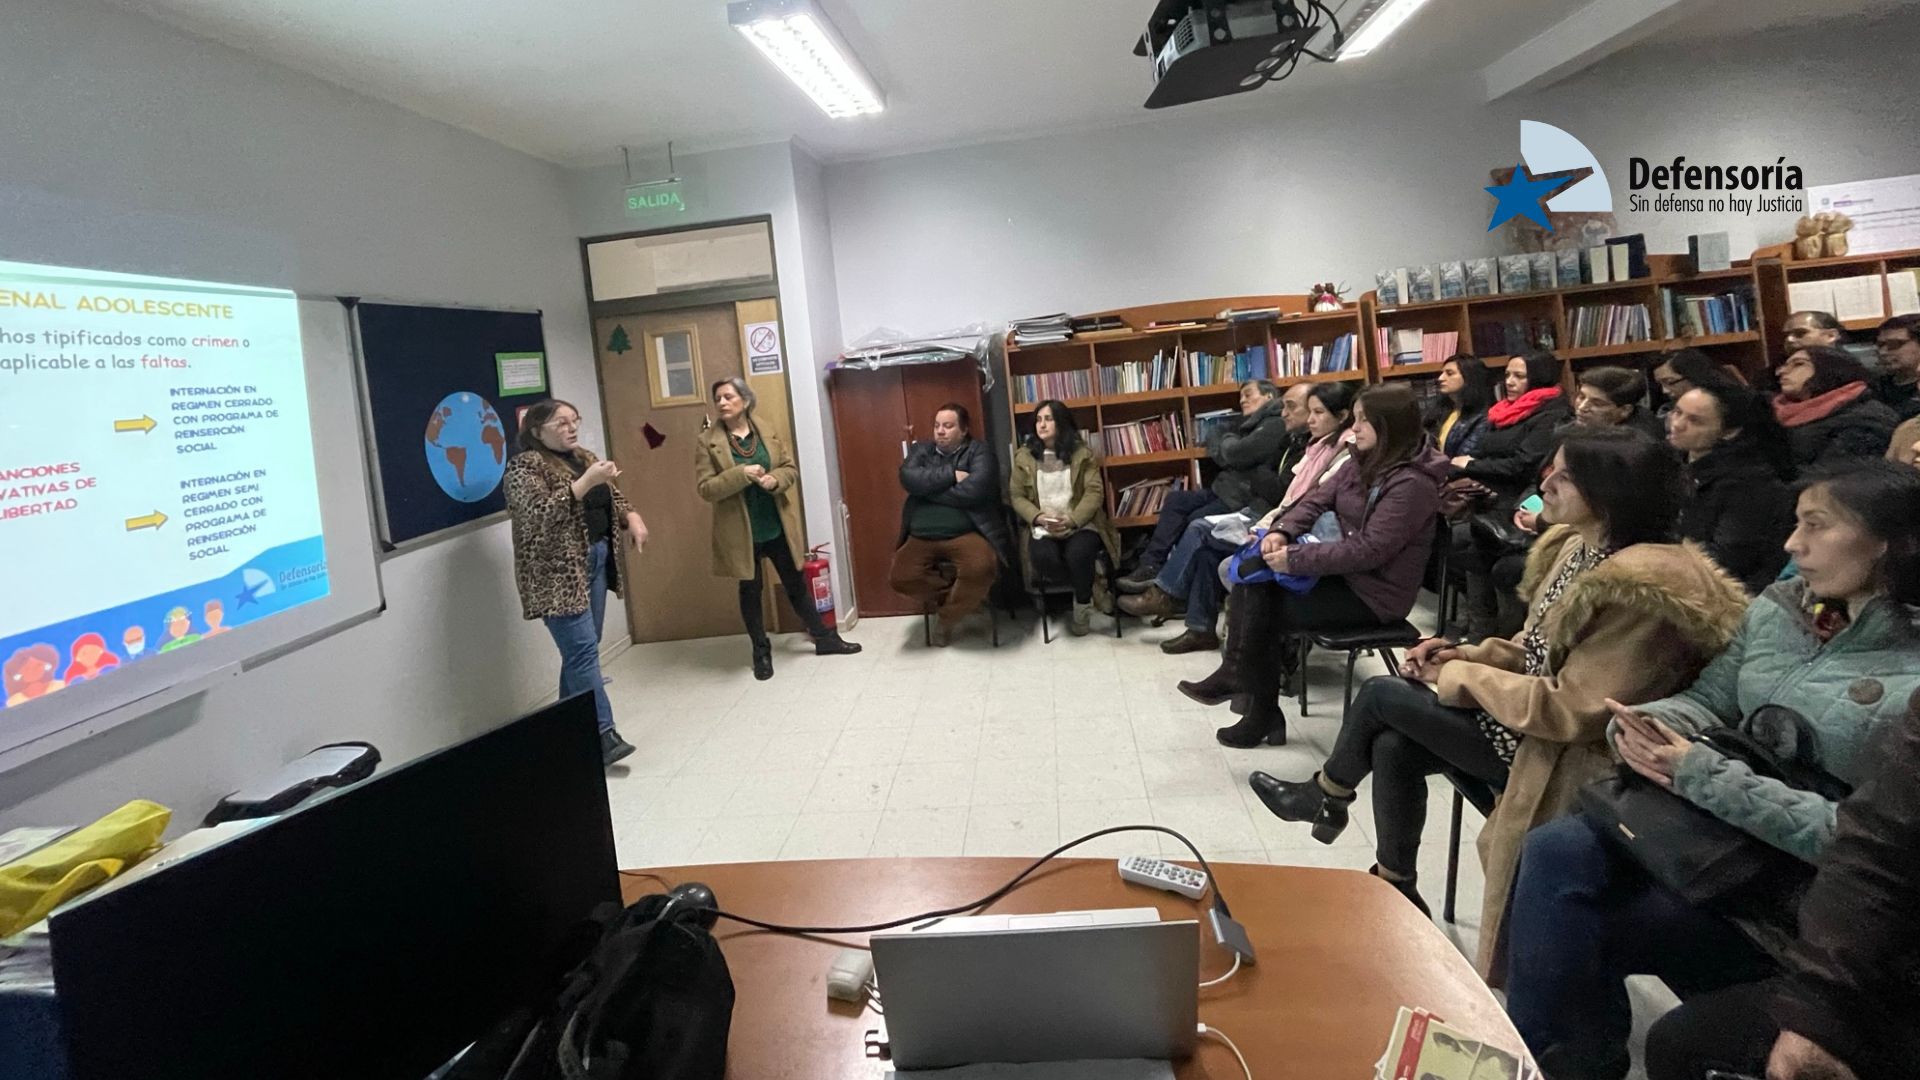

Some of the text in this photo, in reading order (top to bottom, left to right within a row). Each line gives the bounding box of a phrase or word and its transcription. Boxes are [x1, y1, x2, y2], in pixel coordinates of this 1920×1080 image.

[628, 192, 681, 209] SALIDA
[77, 296, 234, 319] ADOLESCENTE
[0, 327, 250, 349] hos tipificados como crimen o
[0, 353, 192, 374] aplicable a las faltas.
[170, 385, 241, 396] INTERNACIÓN
[171, 398, 273, 411] REGIMEN CERRADO
[173, 410, 279, 425] CON PROGRAMA DE
[175, 425, 245, 439] REINSERCIÓN
[176, 442, 217, 454] SOCIAL
[75, 477, 97, 490] DE
[180, 469, 266, 489] INTERNACIÓN EN
[182, 483, 259, 504] REGIMEN SEMI
[184, 495, 263, 518] CERRADO CON
[185, 508, 267, 532] PROGRAMA DE
[187, 524, 257, 547] REINSERCIÓN
[189, 545, 230, 561] SOCIAL
